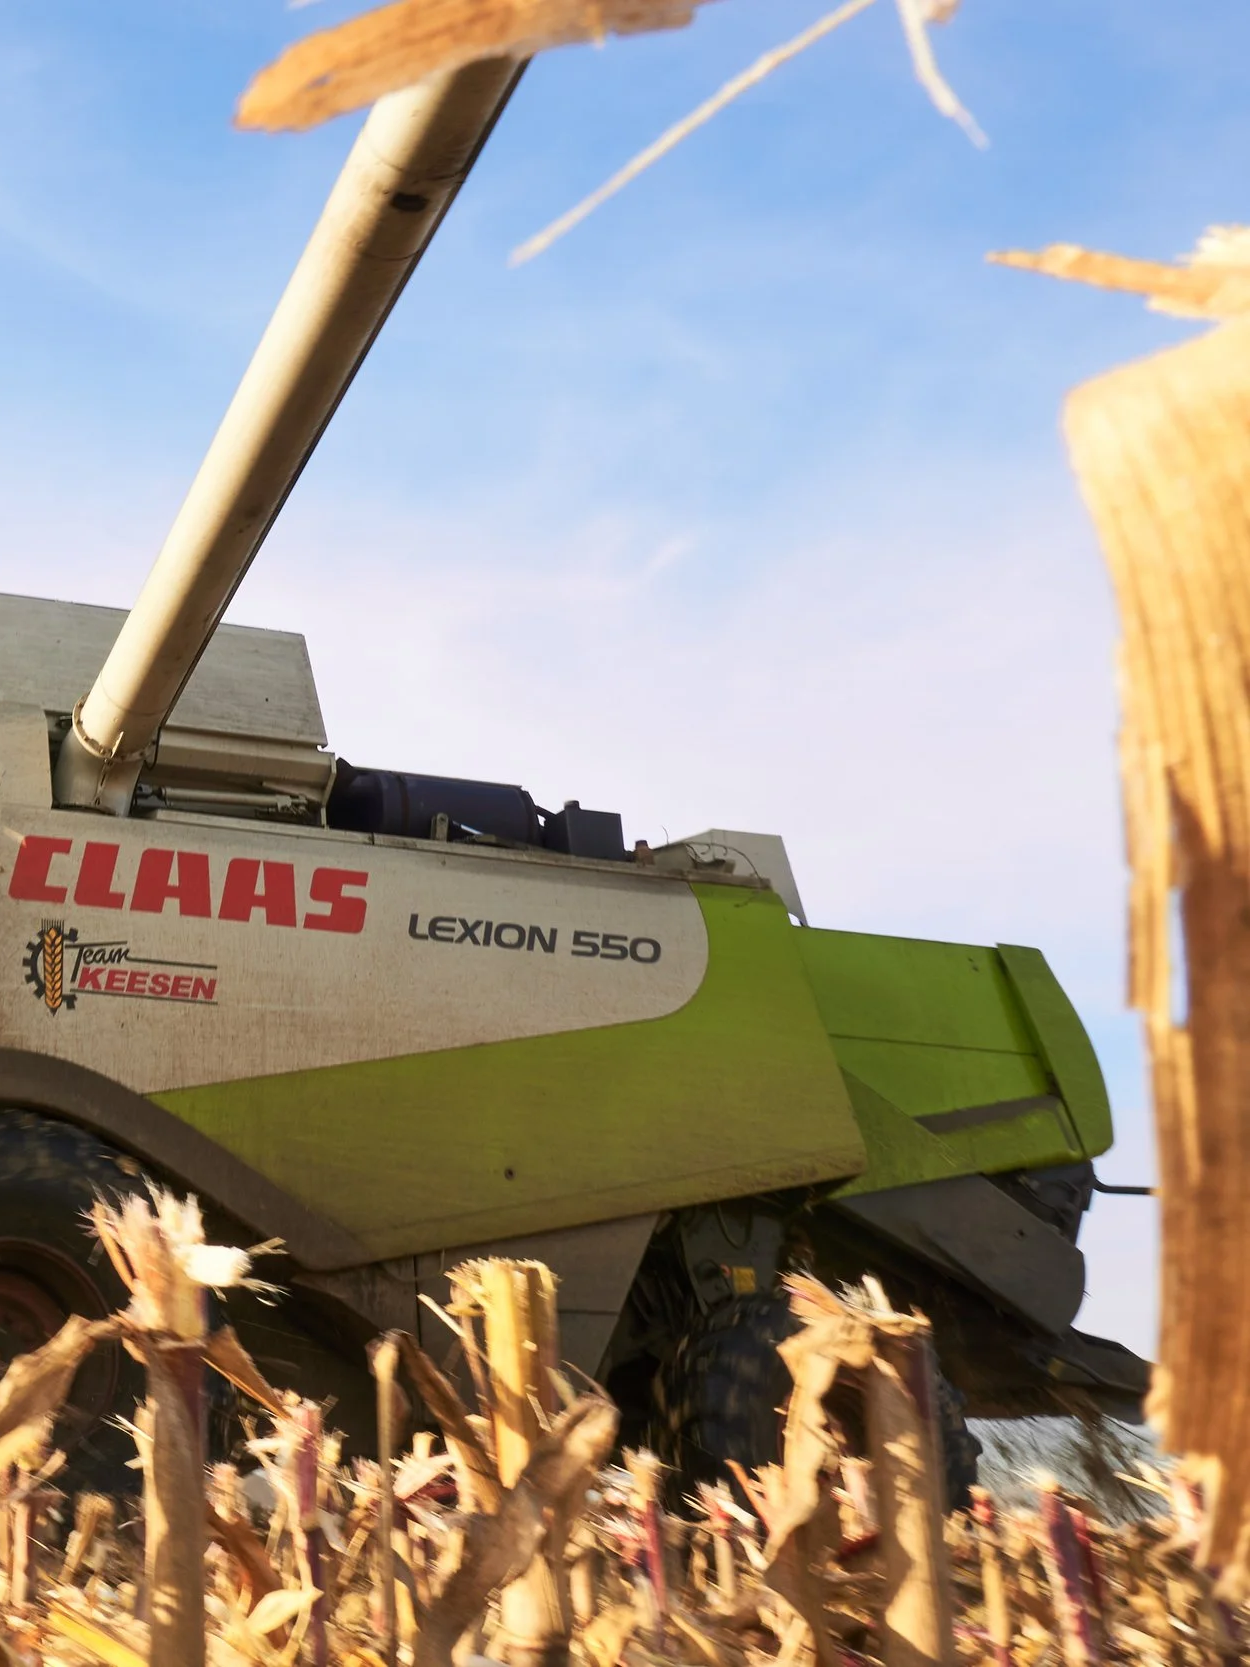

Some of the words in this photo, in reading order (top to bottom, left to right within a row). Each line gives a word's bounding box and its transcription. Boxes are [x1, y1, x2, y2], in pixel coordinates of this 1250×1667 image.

[8, 835, 369, 934] CLAAS
[65, 940, 130, 983] Team
[408, 913, 558, 954] LEXION
[571, 930, 662, 964] 550
[77, 966, 217, 1000] KEESEN
